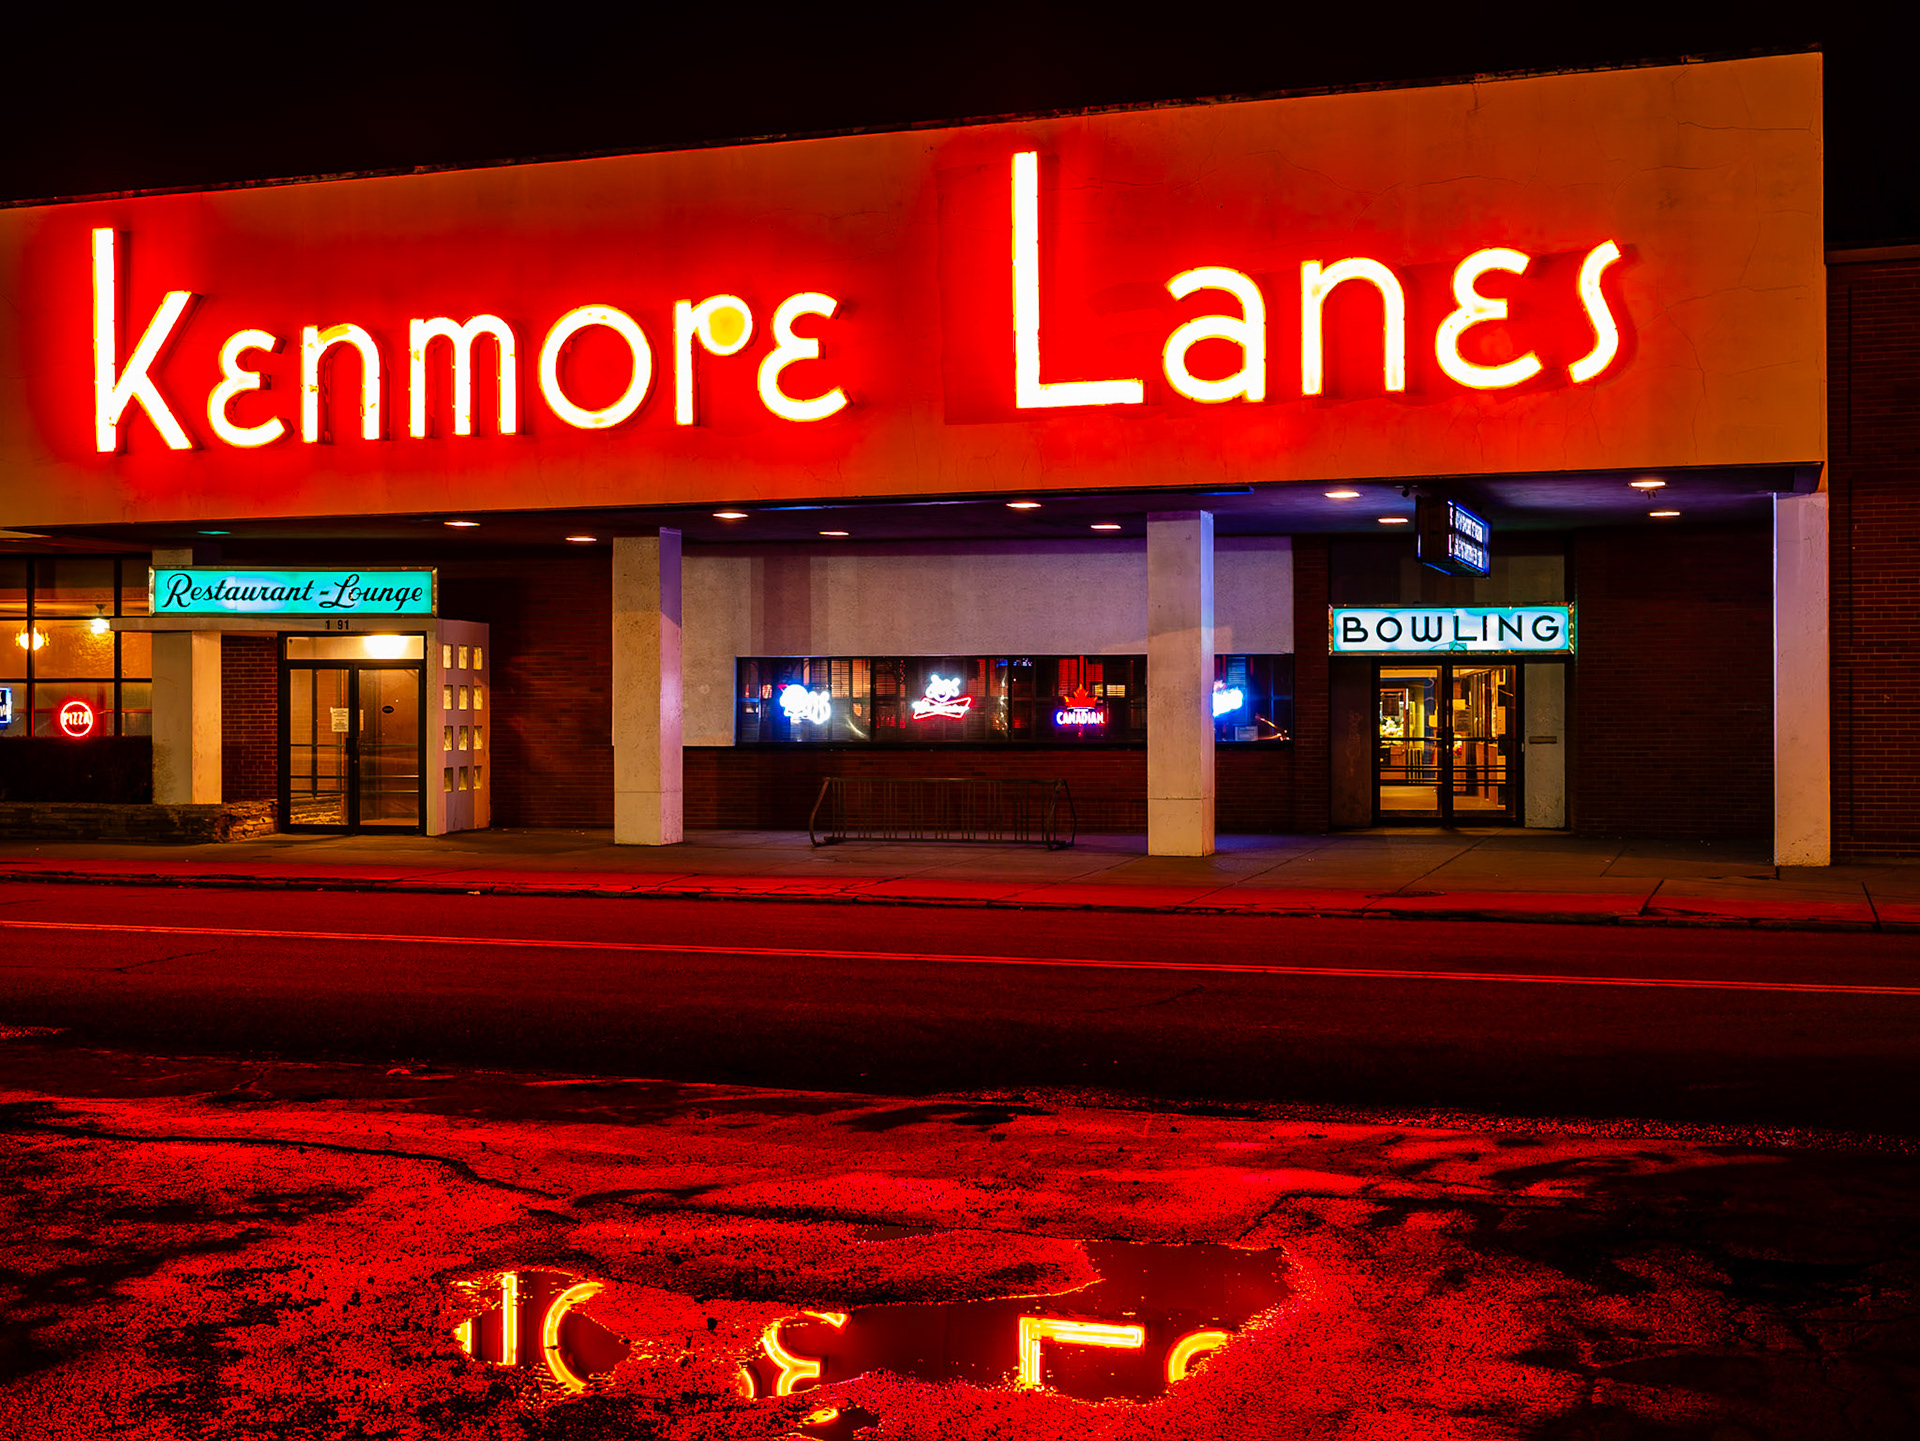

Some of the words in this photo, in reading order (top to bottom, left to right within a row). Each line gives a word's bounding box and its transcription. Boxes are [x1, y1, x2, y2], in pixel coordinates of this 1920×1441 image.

[1011, 151, 1622, 410] Lanes
[1342, 615, 1559, 643] BOWLING
[63, 711, 90, 726] PIZZA
[1056, 710, 1105, 725] CANADIAN
